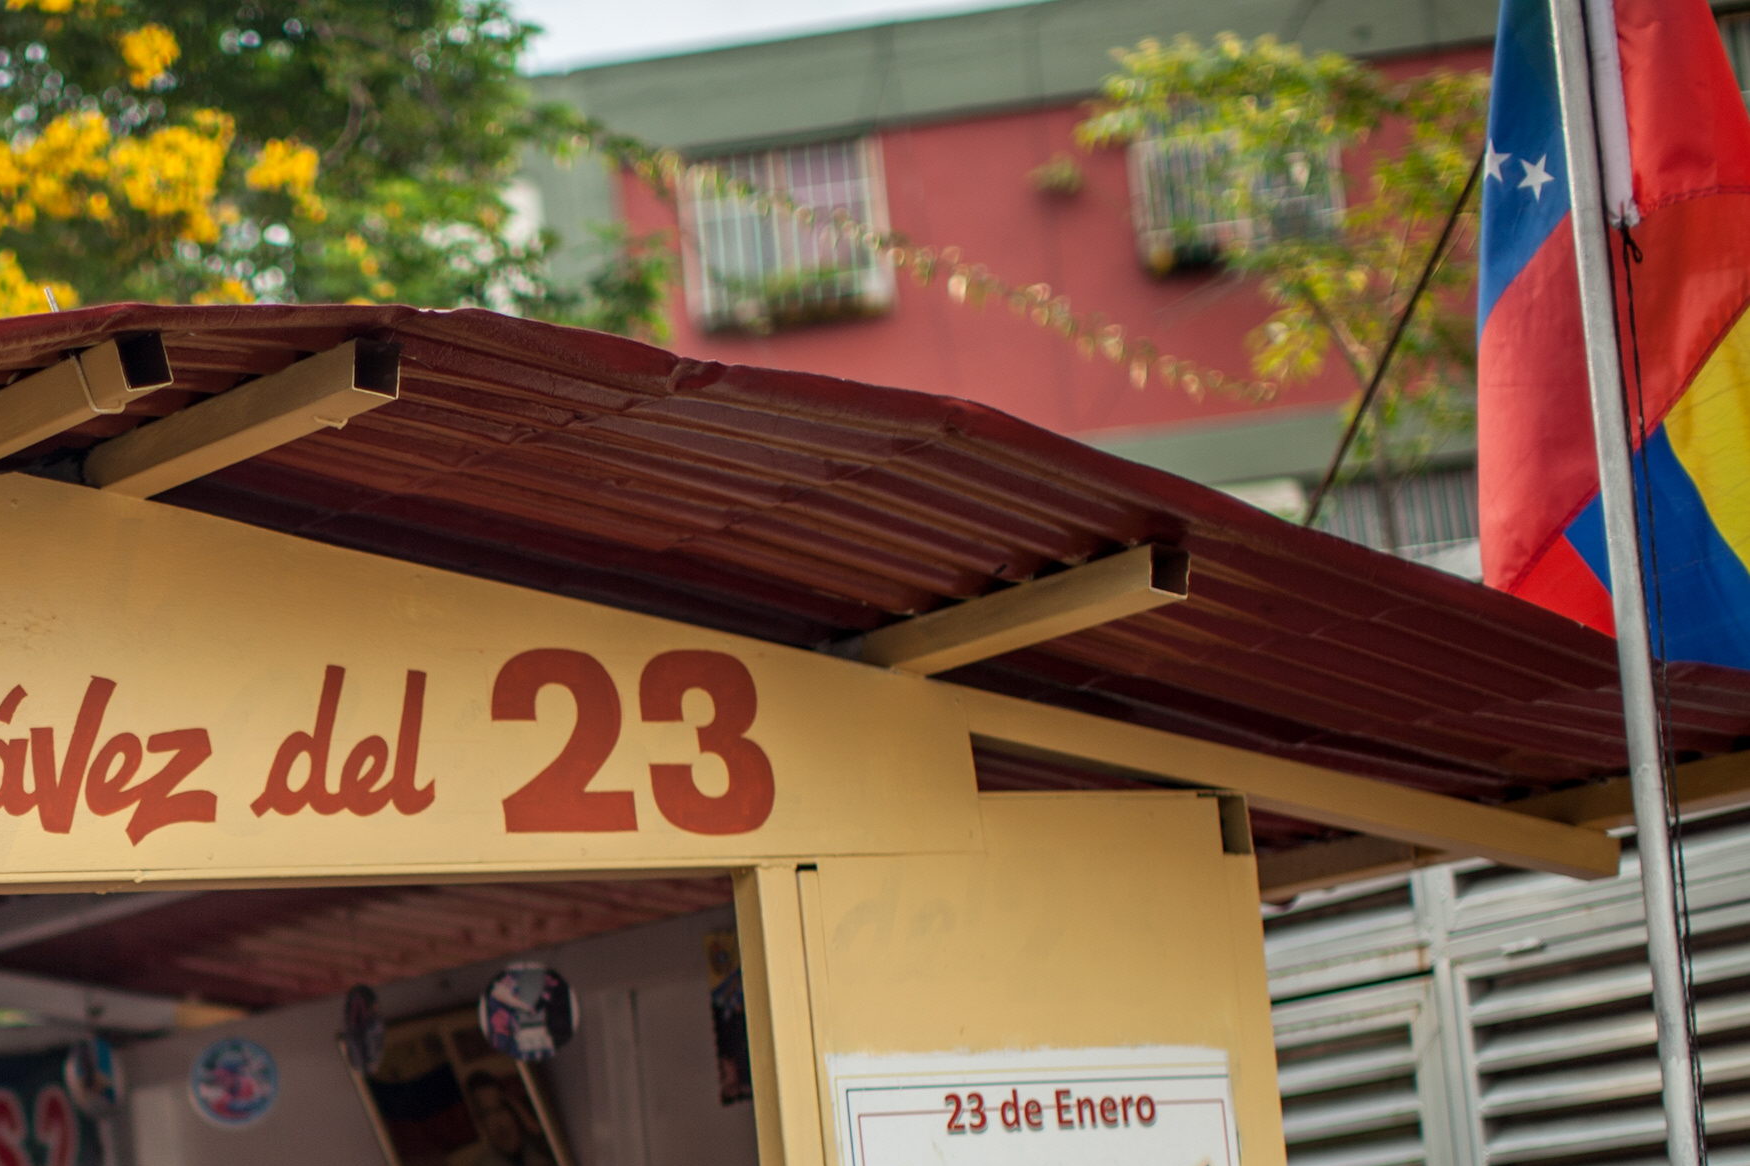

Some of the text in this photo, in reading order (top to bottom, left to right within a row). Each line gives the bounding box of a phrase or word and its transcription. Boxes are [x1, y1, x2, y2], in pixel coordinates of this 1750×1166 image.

[250, 664, 436, 817] del
[491, 648, 776, 835] 23
[944, 1088, 1156, 1133] 23 de Enero
